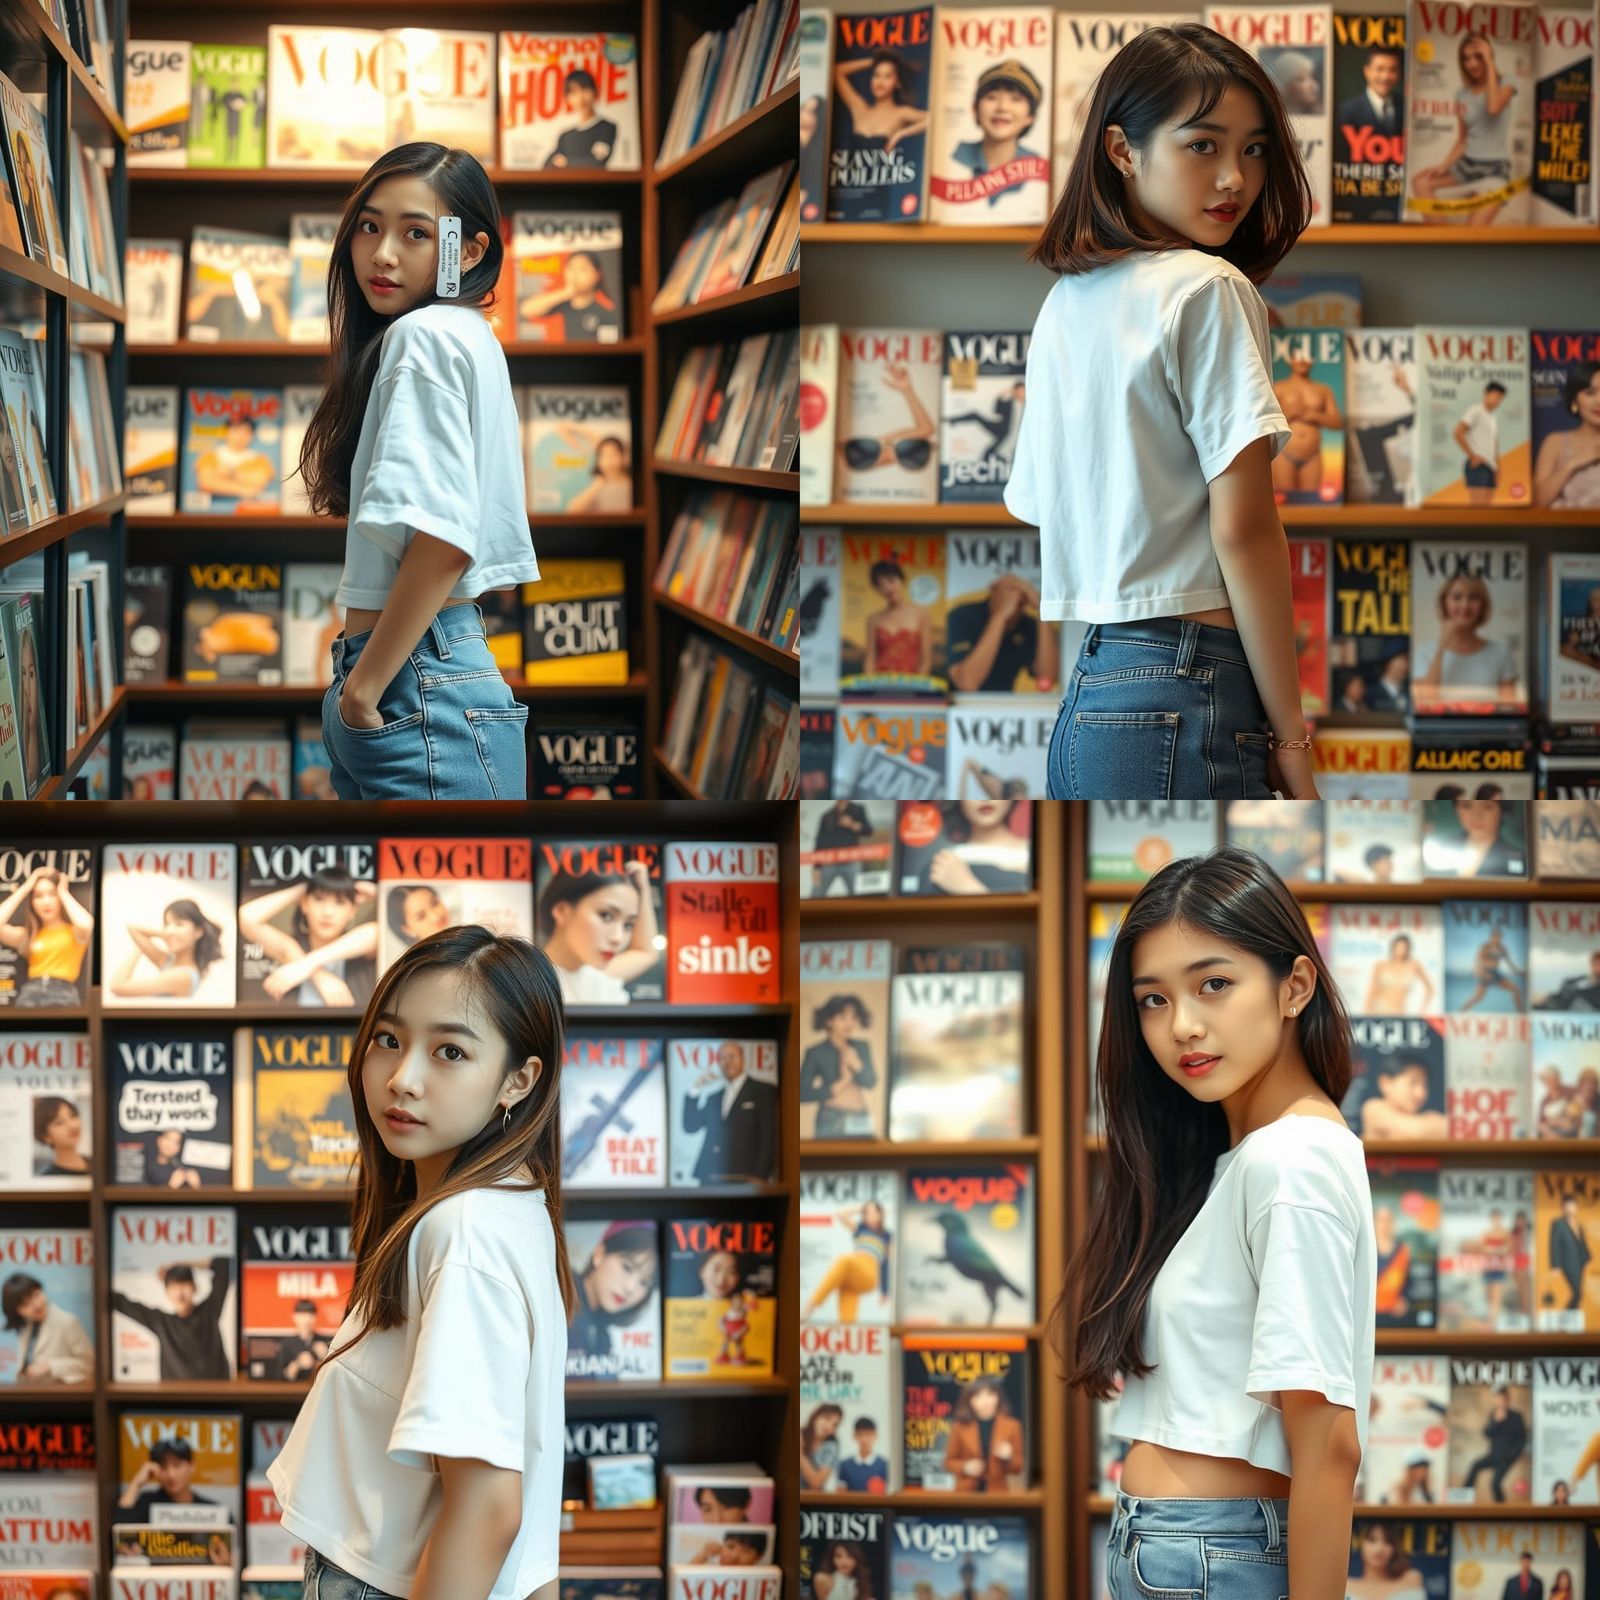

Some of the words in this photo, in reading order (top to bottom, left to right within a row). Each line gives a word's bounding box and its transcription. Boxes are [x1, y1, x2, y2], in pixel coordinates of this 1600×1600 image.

[840, 11, 930, 49] VOGUE
[1211, 13, 1325, 46] VOGUE
[1416, 1, 1536, 43] VOGUE
[840, 333, 941, 364] VOGUE
[1424, 334, 1525, 364] VOGUE
[843, 536, 946, 567] VOGUE
[1421, 549, 1524, 581] VOGUE
[538, 734, 637, 767] VOGUE
[116, 851, 230, 882] VOGUE
[251, 845, 375, 881] VOGUE
[388, 842, 529, 881] VOGUE
[542, 844, 662, 879] VOGUE
[674, 847, 777, 877] VOGUE
[678, 935, 773, 976] sinle
[118, 1041, 228, 1076] VOGUE
[168, 1106, 210, 1121] work
[119, 1215, 228, 1247] VOGUE
[671, 1221, 776, 1255] VOGUE
[123, 1418, 235, 1455] VOGUE
